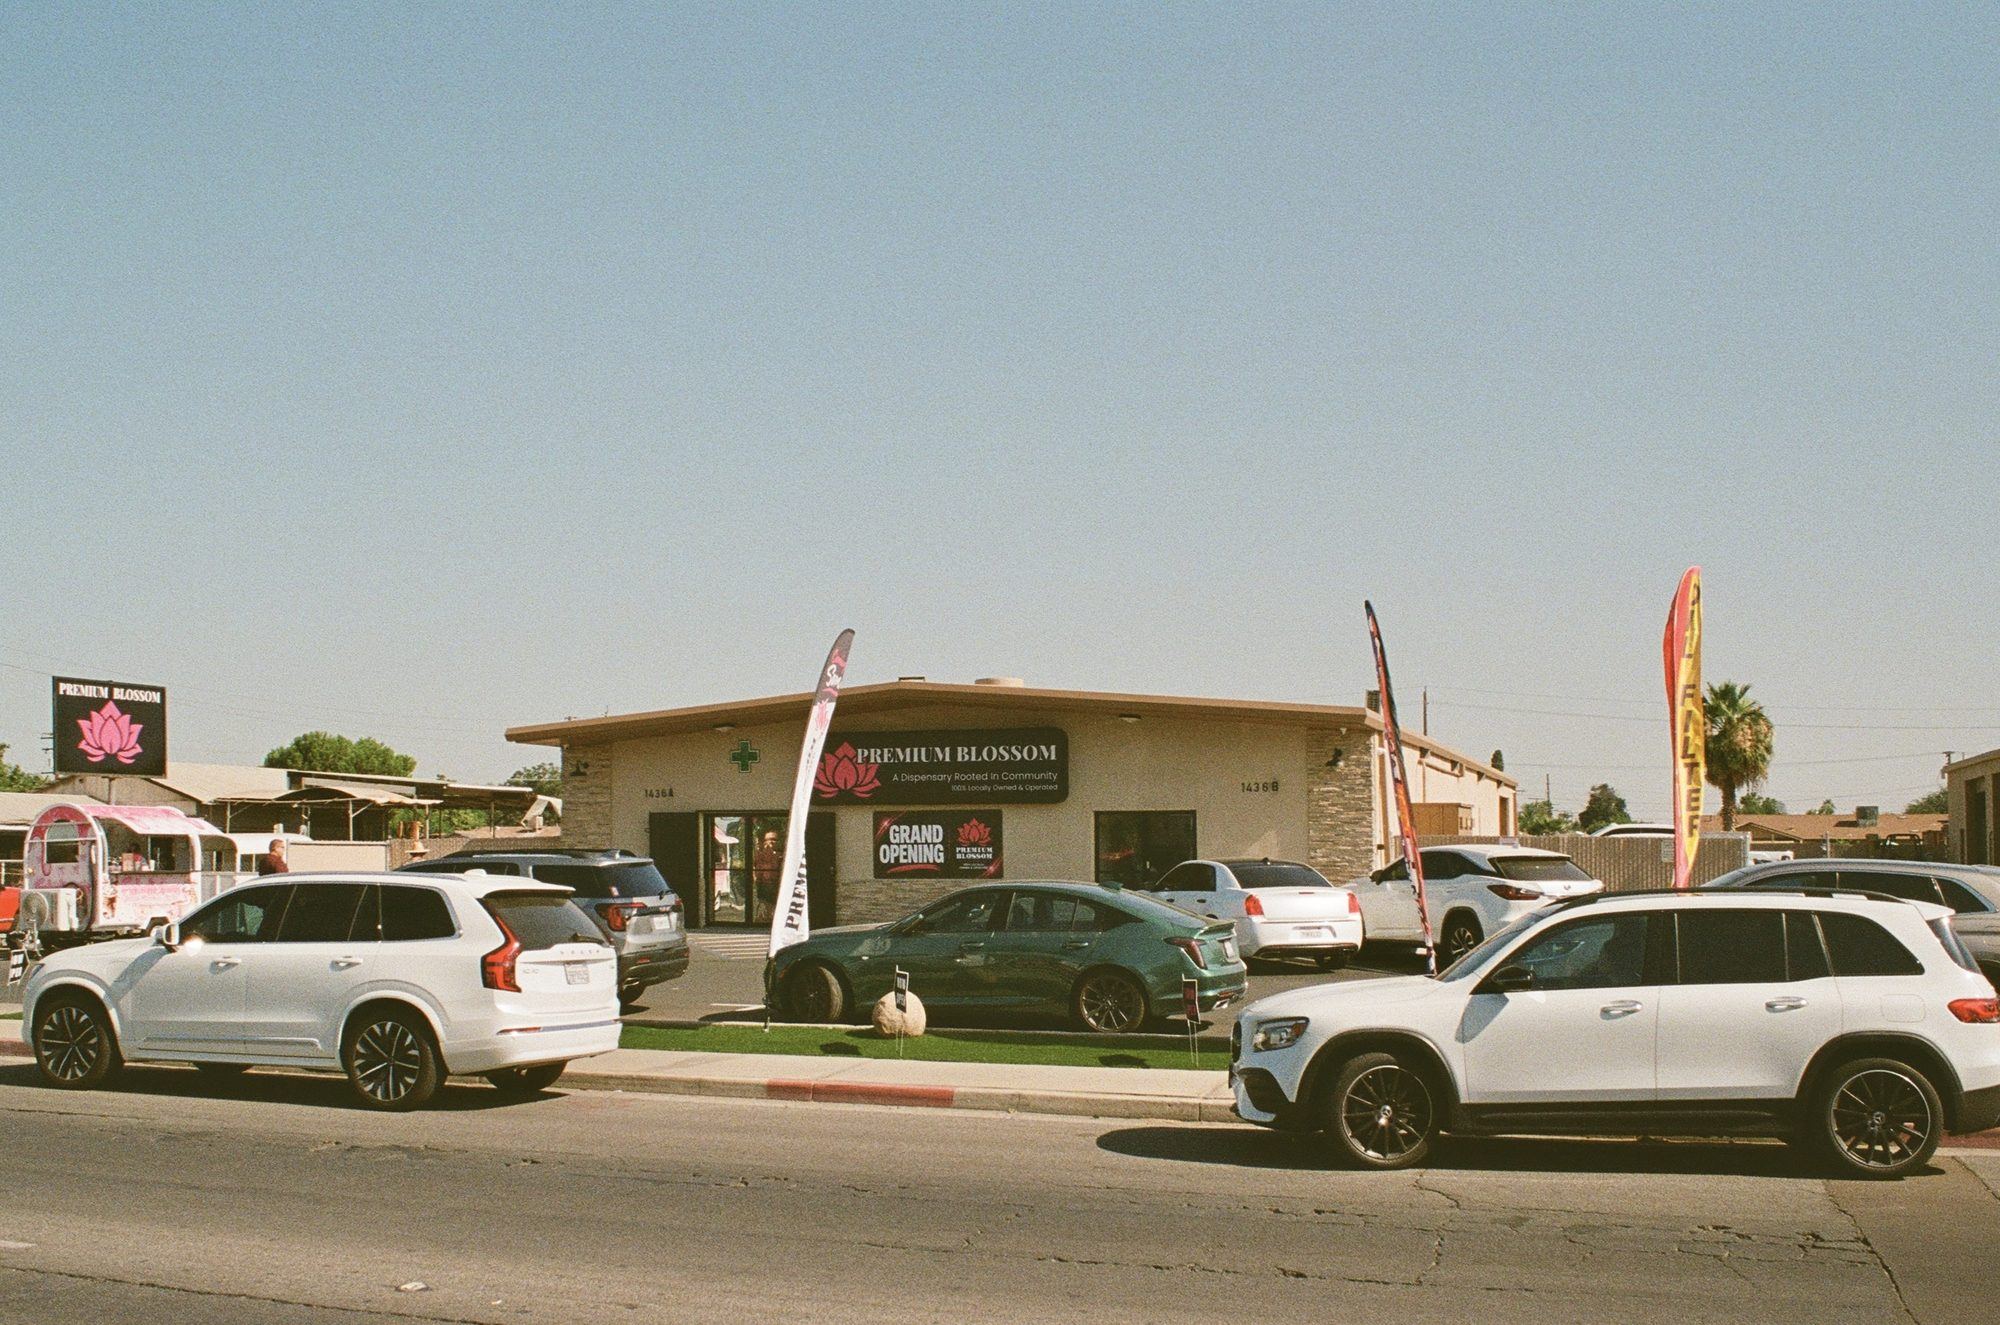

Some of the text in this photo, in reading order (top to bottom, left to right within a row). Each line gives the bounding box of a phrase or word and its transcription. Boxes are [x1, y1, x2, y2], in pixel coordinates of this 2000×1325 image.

[59, 682, 160, 703] PREMIUM BLOSSOM
[856, 745, 1057, 763] PREMIUM BLOSSOM
[893, 771, 1058, 783] A Dispensary Rooted In Community
[968, 784, 991, 792] Locally
[1025, 784, 1058, 792] Operated
[889, 824, 943, 844] GRAND
[879, 843, 945, 864] OPENING
